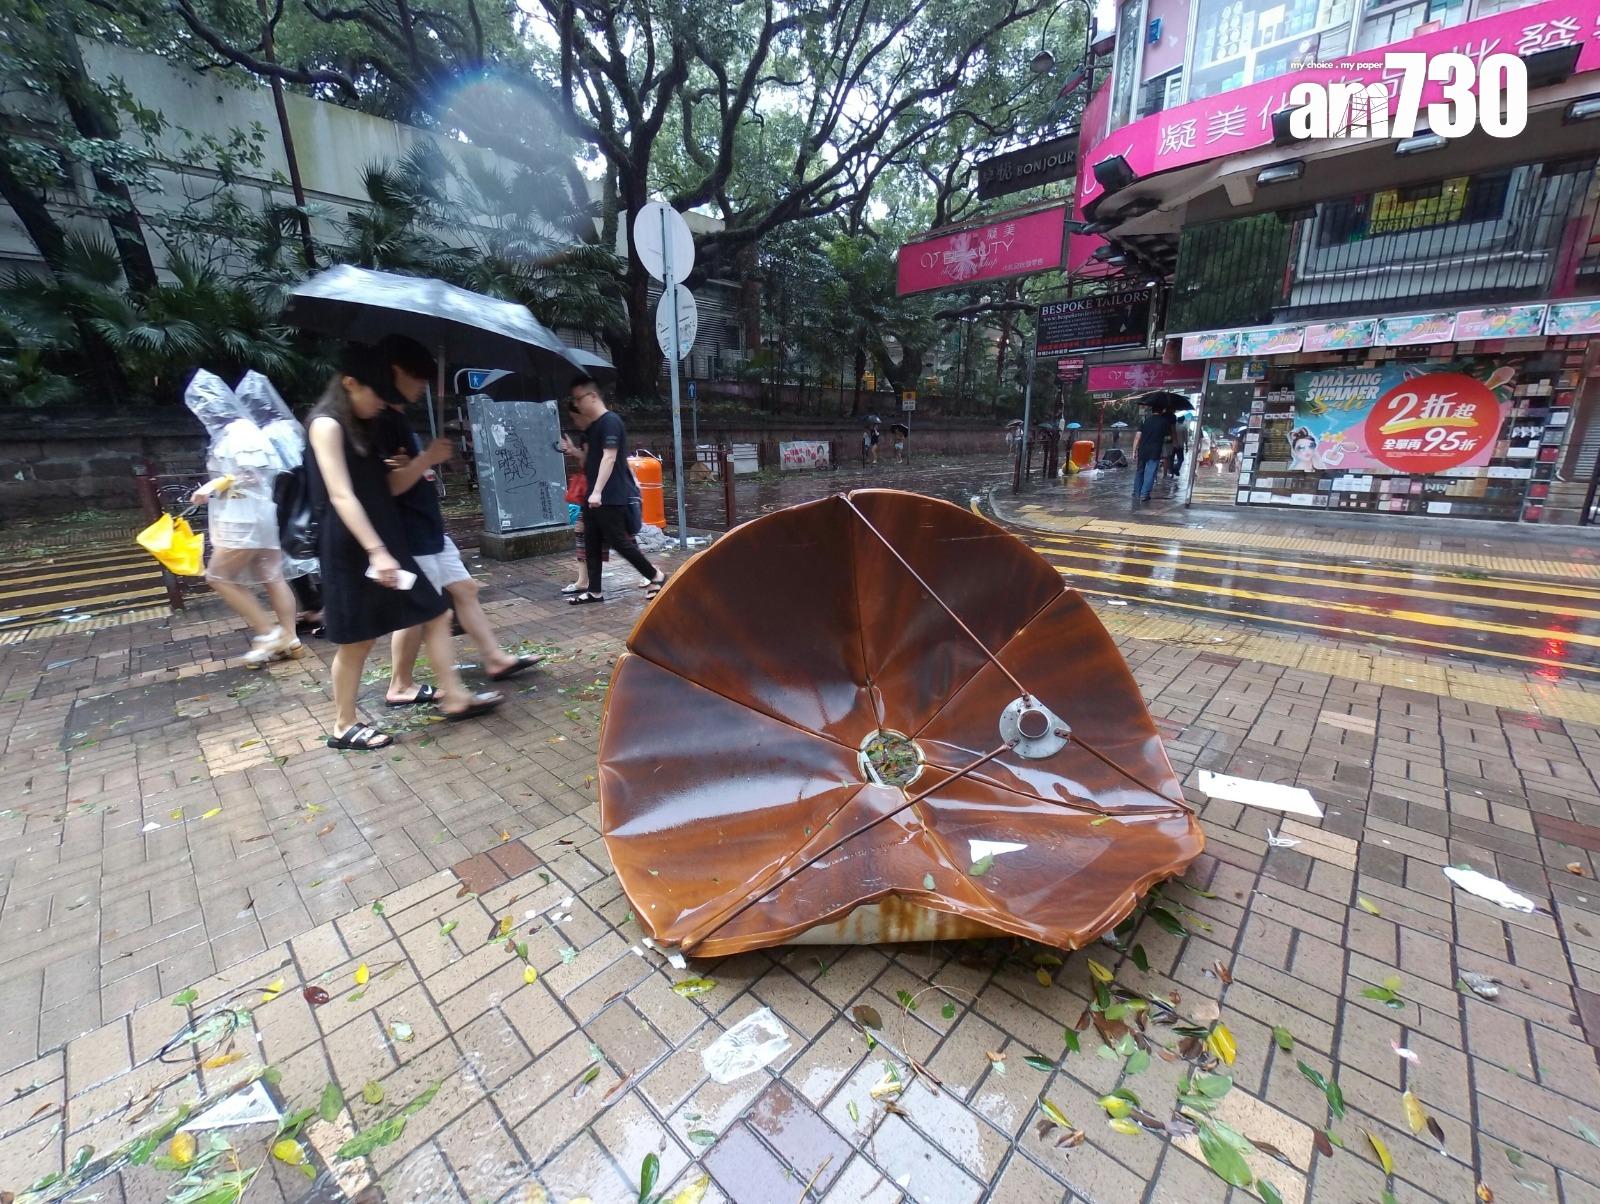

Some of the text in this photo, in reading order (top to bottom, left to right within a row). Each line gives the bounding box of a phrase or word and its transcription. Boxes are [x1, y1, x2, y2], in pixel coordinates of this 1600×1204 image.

[1017, 151, 1075, 177] BONJOUR
[943, 238, 1015, 265] BEAUTY
[1041, 290, 1150, 316] BESPOKE TAILORS
[1308, 373, 1382, 388] AMAZING
[1305, 386, 1381, 402] SUMMER
